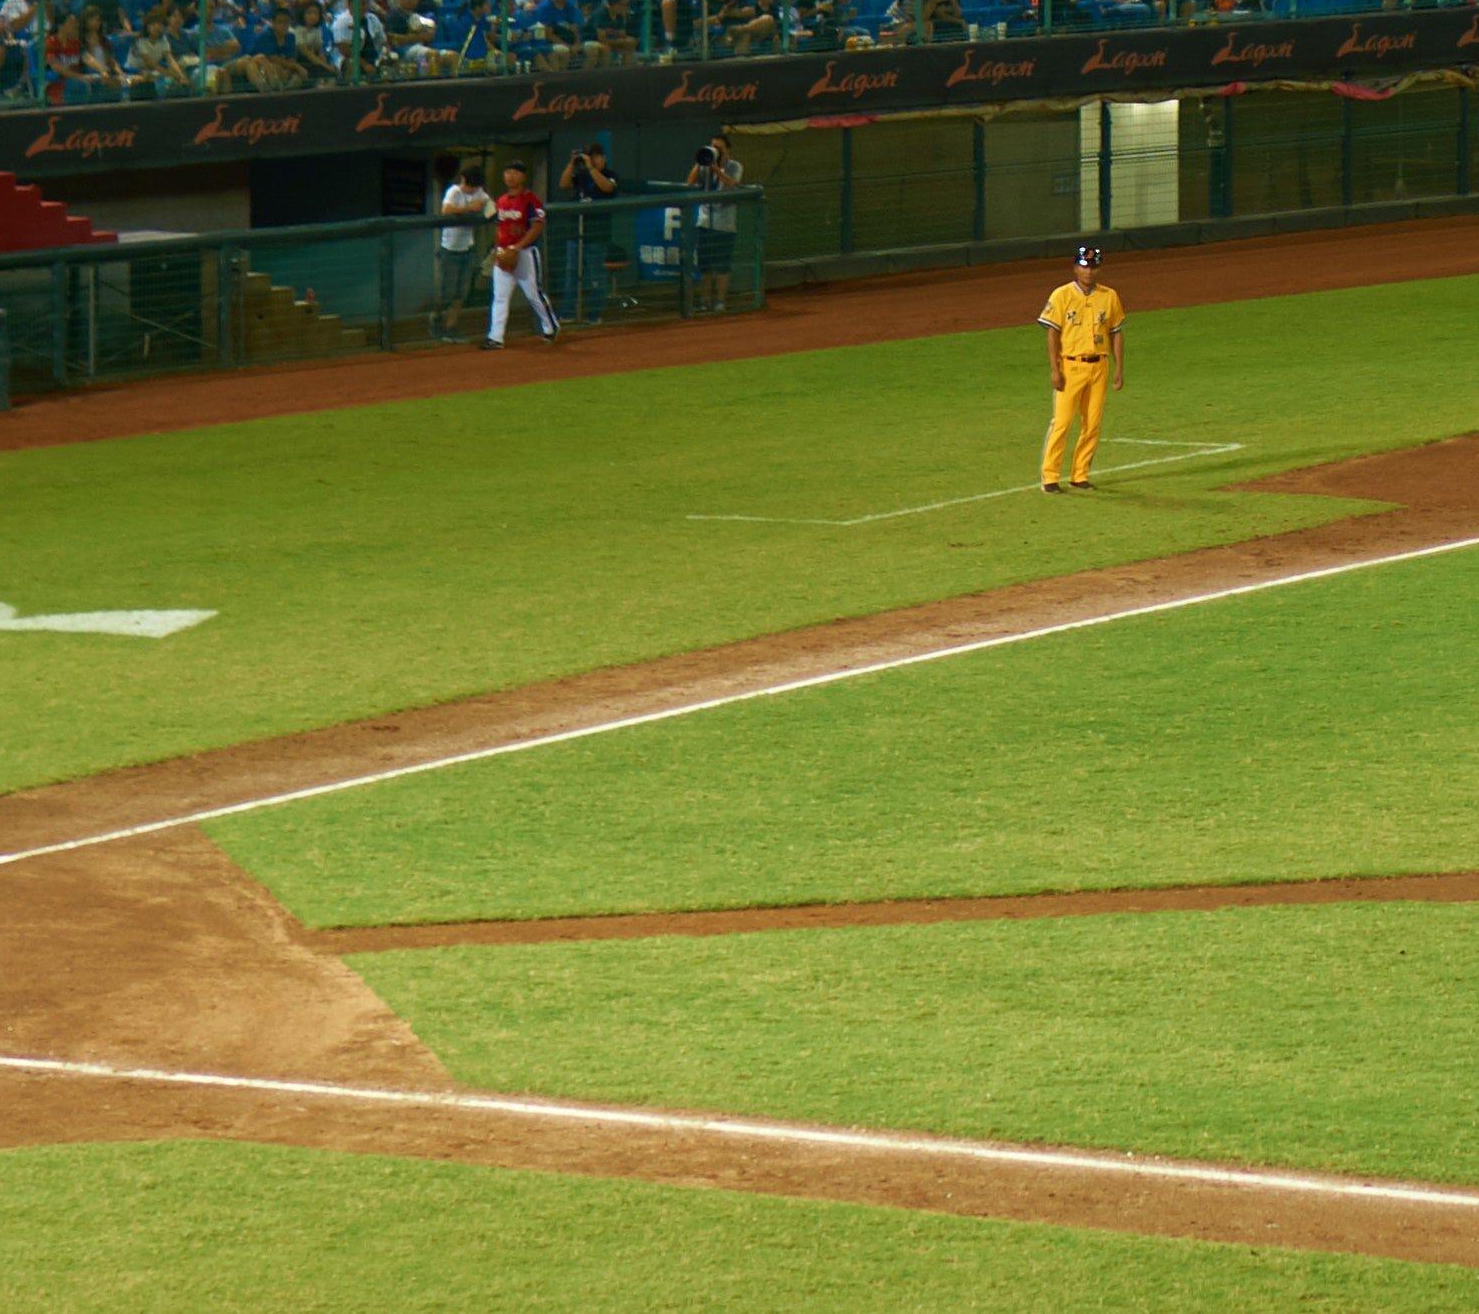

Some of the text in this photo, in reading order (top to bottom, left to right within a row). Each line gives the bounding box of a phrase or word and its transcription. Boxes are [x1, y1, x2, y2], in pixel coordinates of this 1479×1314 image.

[946, 48, 1037, 88] Lagoon
[1081, 37, 1169, 76] Lagoon
[1211, 31, 1296, 68] Lagoon
[662, 71, 760, 110] Lagoon
[806, 60, 901, 99] Lagoon
[354, 92, 461, 134] Lagoon
[511, 80, 613, 123] Lagoon
[24, 115, 137, 160] Lagoon
[194, 103, 302, 146] Lagoon
